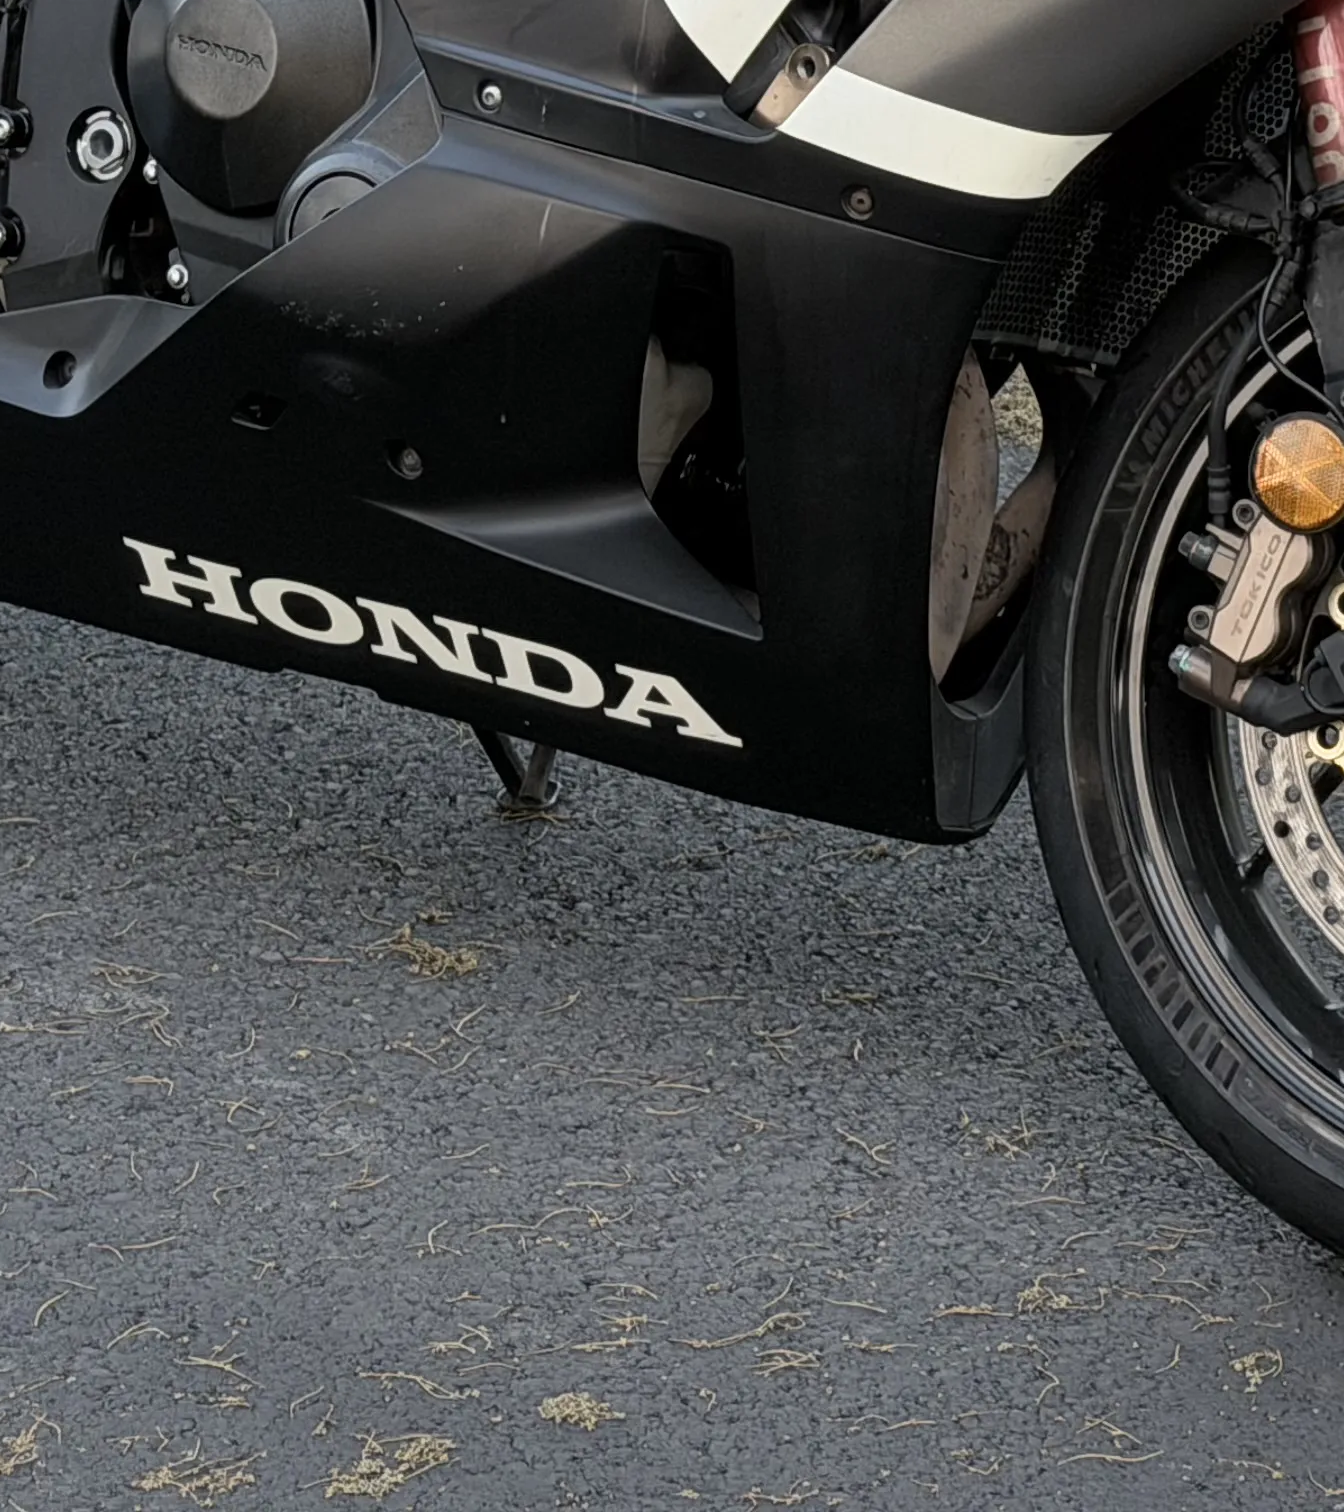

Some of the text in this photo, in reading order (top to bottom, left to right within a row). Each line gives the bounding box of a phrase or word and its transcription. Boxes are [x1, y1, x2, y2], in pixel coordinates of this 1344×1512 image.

[177, 33, 268, 73] HONDA
[1230, 533, 1283, 637] TOKICO
[122, 535, 744, 749] HONDA
